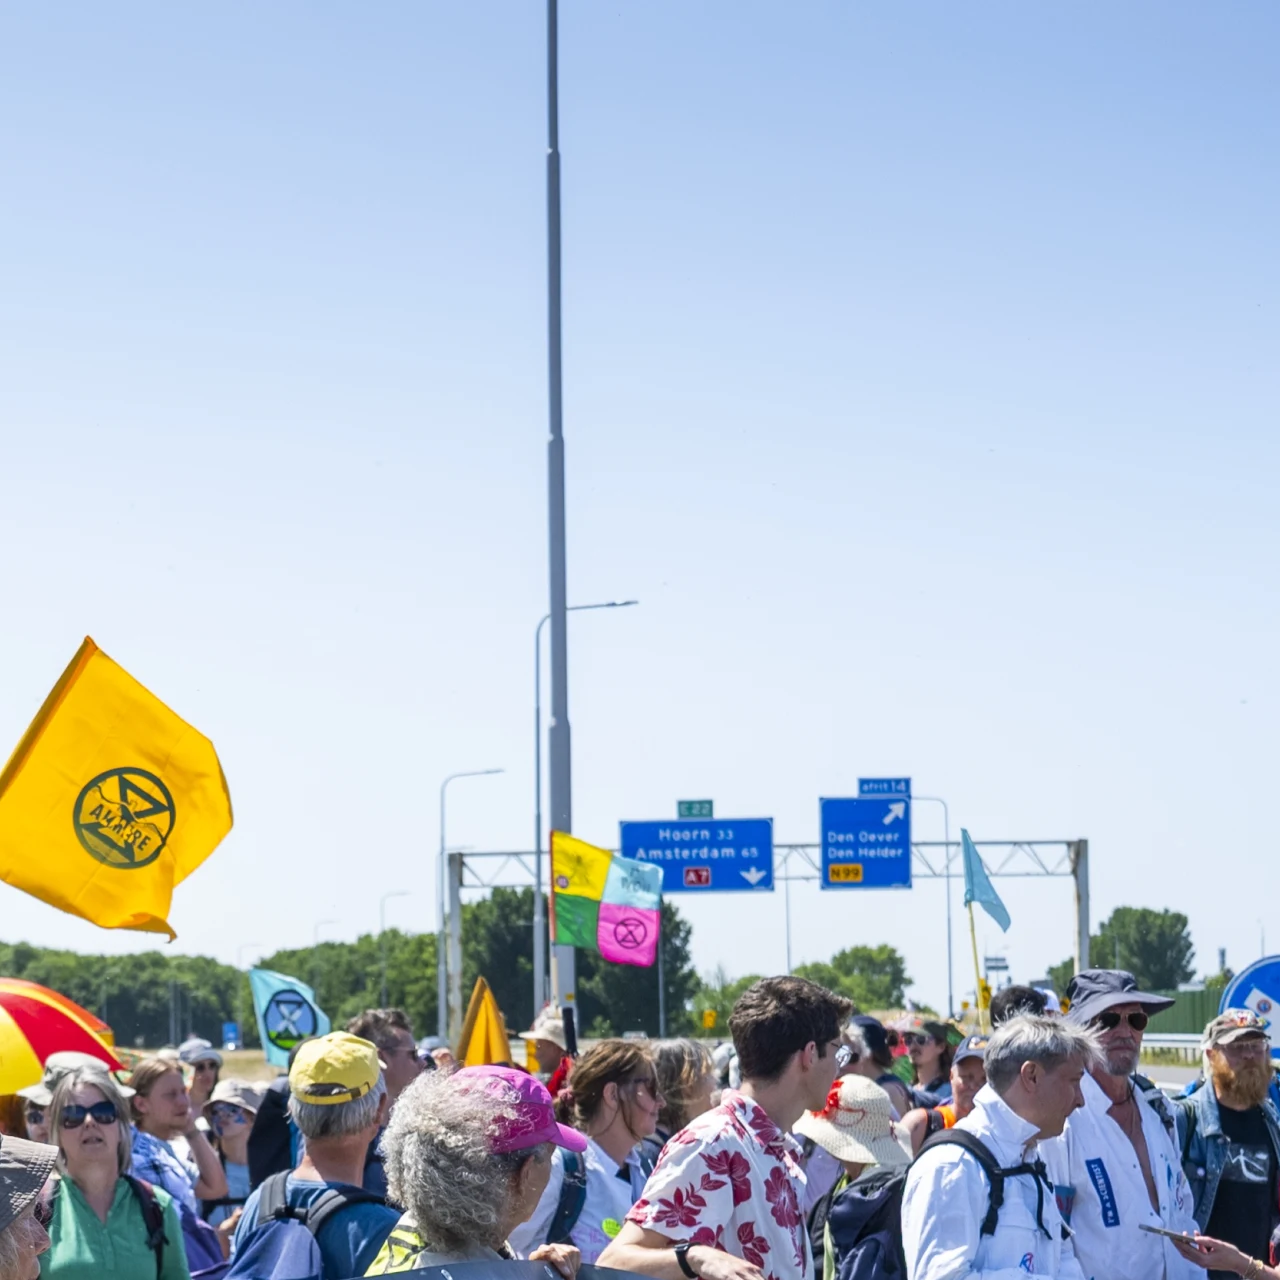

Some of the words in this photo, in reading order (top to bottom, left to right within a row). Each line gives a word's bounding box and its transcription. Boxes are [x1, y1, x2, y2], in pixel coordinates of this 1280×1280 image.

[862, 781, 888, 792] afrit
[891, 780, 906, 792] 14
[659, 828, 710, 841] Hoorn
[717, 830, 734, 841] 33
[827, 831, 854, 843] Den
[858, 831, 900, 843] Oever
[635, 847, 735, 860] Amsterdam
[741, 847, 759, 859] 65
[827, 847, 854, 859] Den
[858, 847, 903, 858] Helder
